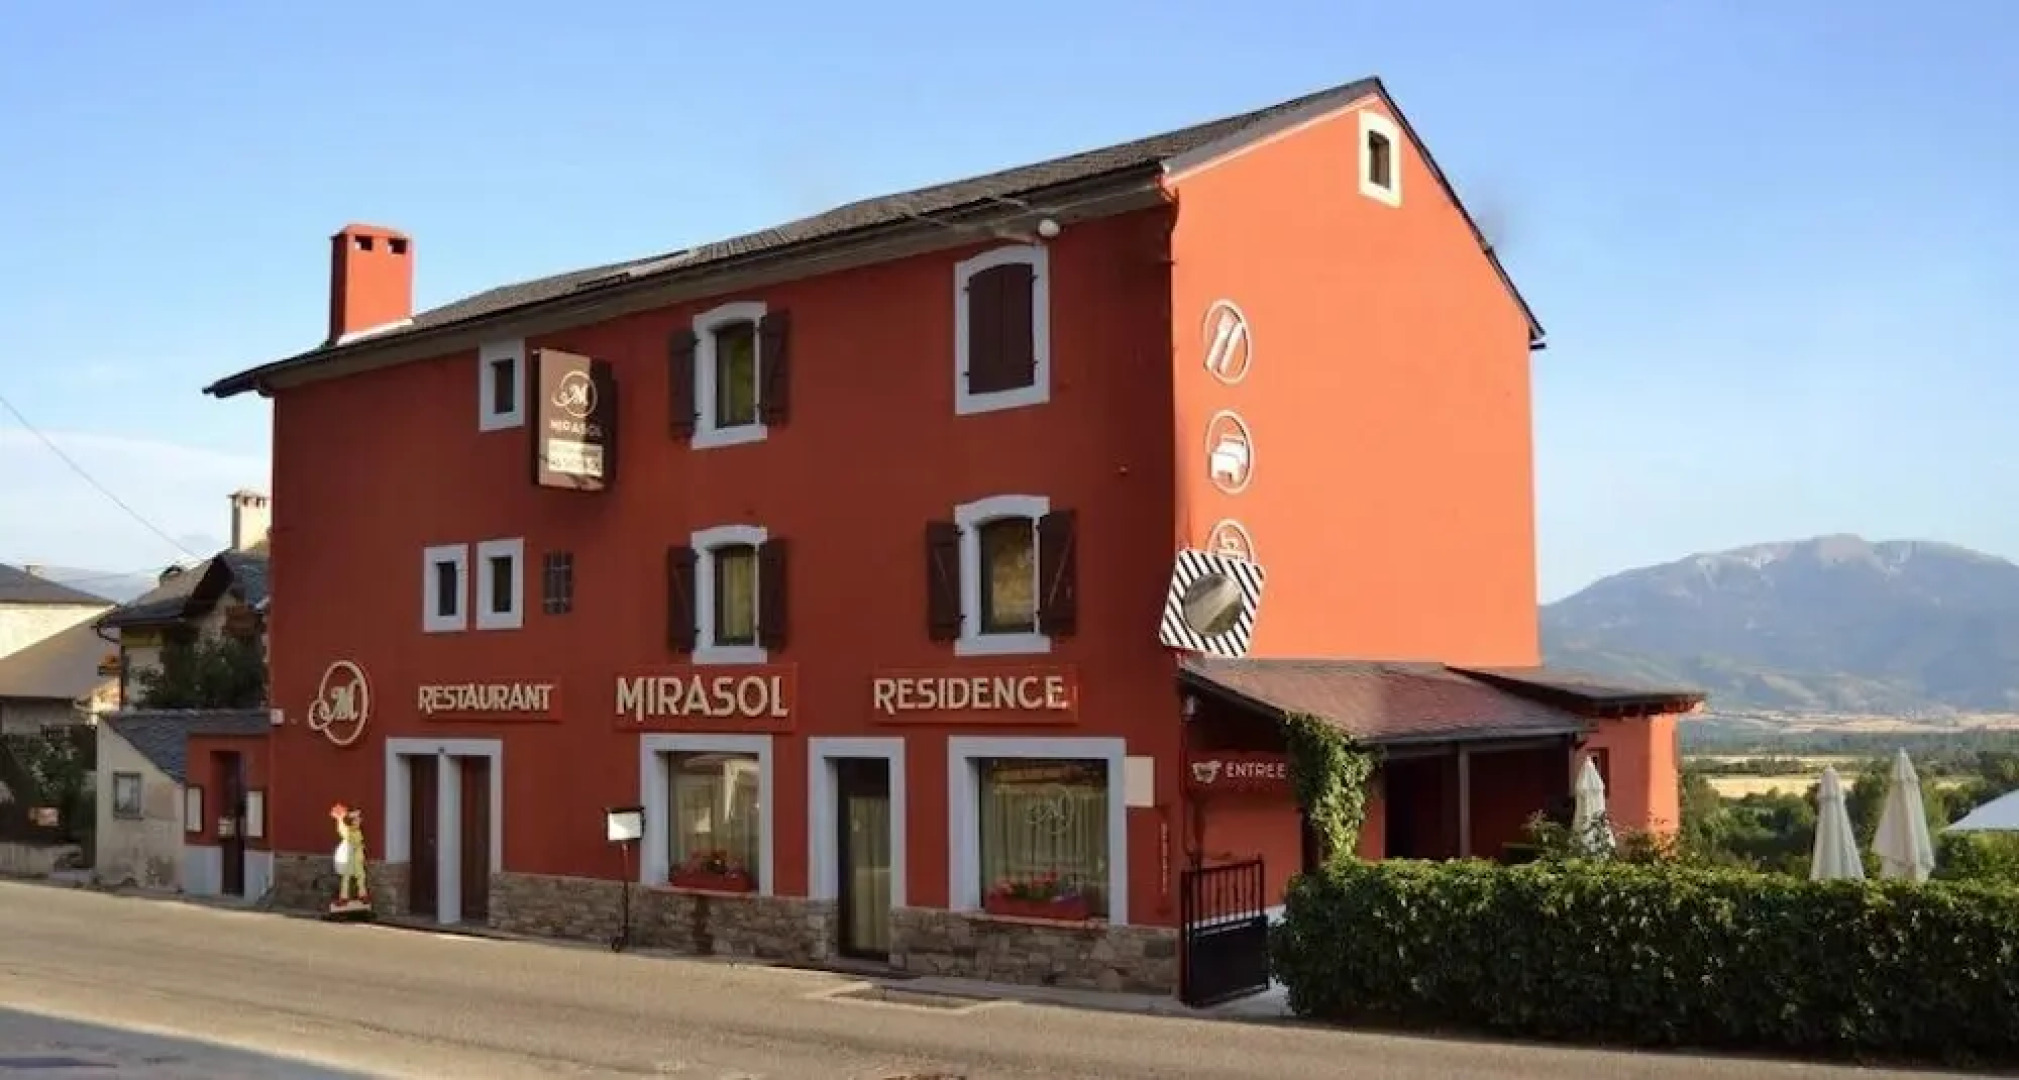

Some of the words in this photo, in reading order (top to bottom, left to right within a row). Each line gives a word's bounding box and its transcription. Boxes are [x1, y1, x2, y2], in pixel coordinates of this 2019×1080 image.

[418, 683, 554, 714] RESTAURANT
[615, 674, 790, 722] MIRASOL
[873, 675, 1069, 715] RESIDENCE
